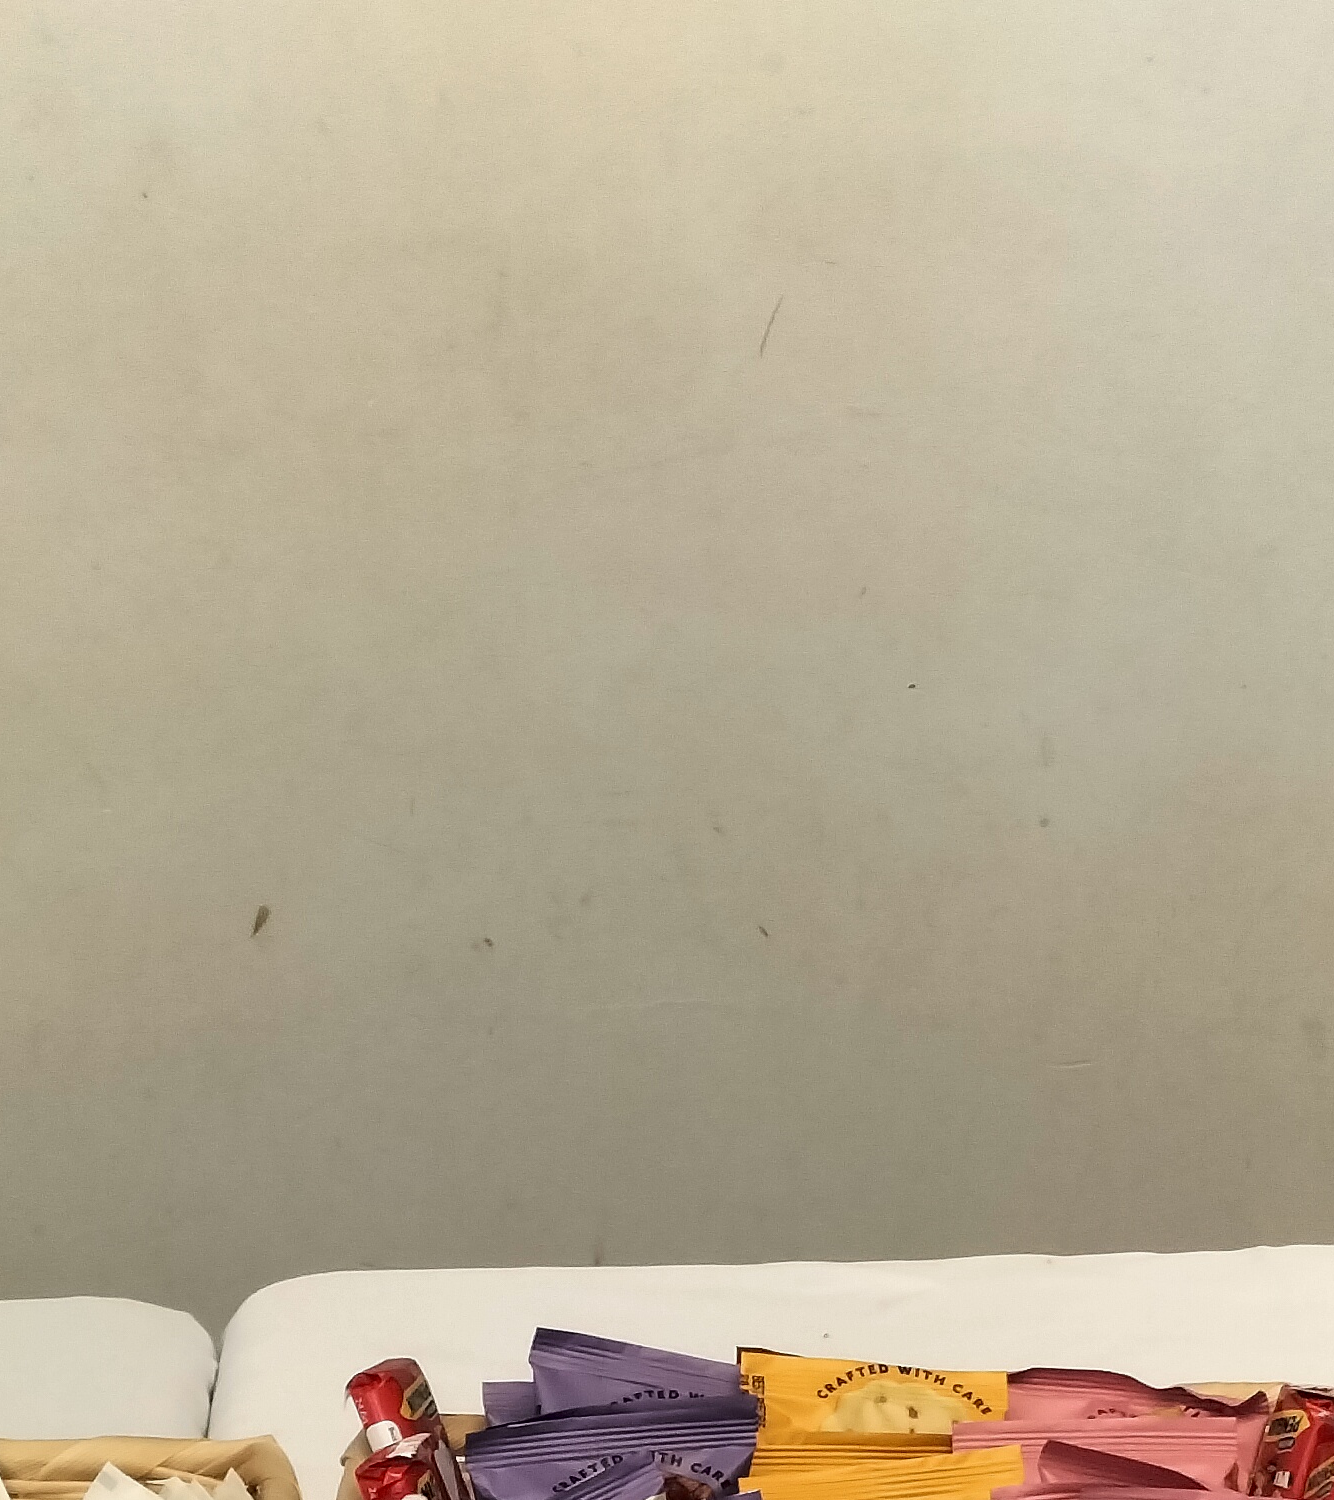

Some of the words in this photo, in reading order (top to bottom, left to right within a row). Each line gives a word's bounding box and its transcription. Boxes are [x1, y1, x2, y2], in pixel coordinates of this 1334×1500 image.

[816, 1363, 889, 1400] CRAFTED
[896, 1364, 947, 1386] WITH
[952, 1382, 993, 1416] CARE
[690, 1462, 732, 1491] CARE
